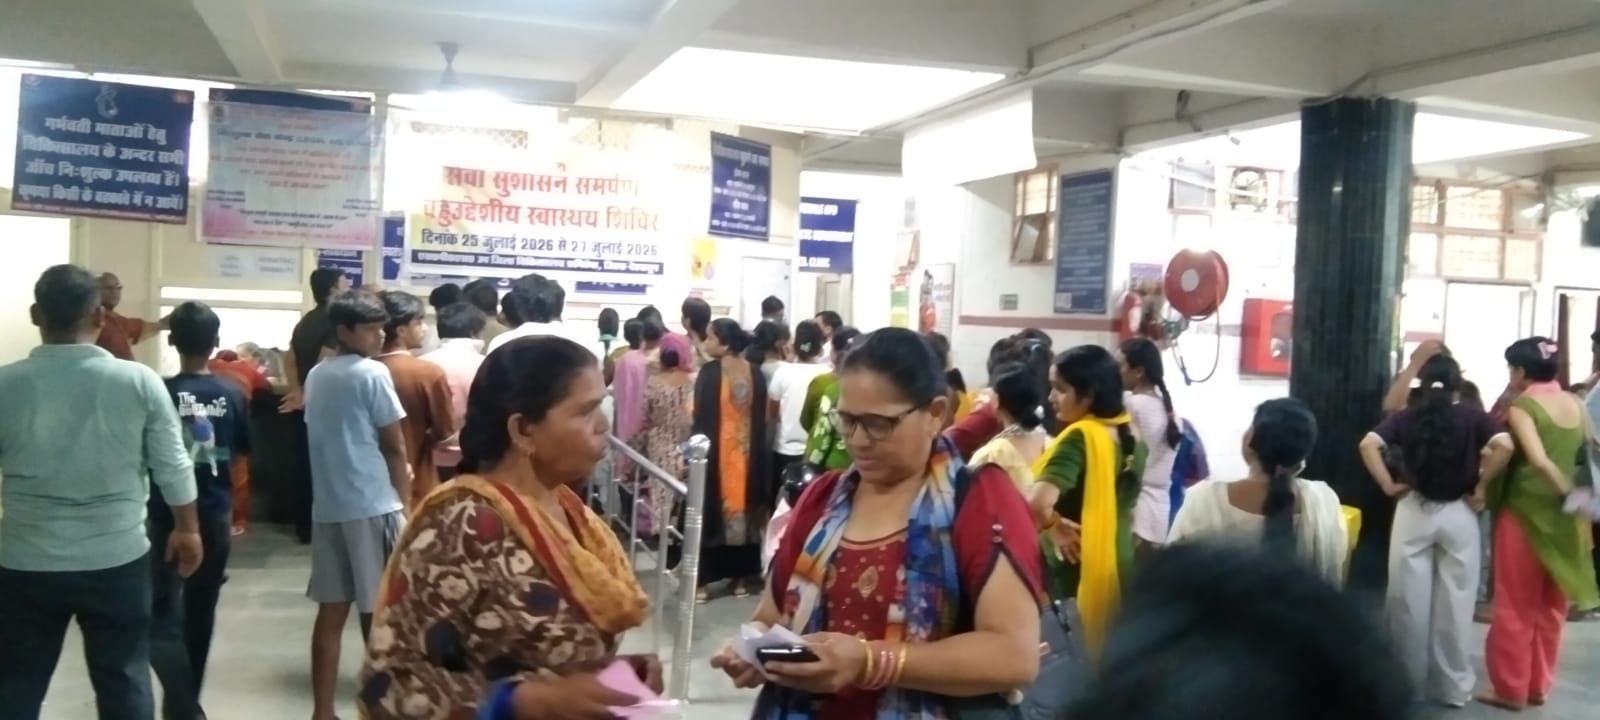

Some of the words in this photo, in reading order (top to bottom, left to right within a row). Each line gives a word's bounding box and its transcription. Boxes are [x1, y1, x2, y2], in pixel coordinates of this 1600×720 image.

[103, 142, 116, 157] के
[421, 227, 458, 245] दिनांक
[462, 234, 478, 247] 25
[482, 233, 516, 252] जुलाई
[521, 238, 553, 251] 2026
[571, 241, 586, 253] 27
[592, 240, 622, 257] जुलाई
